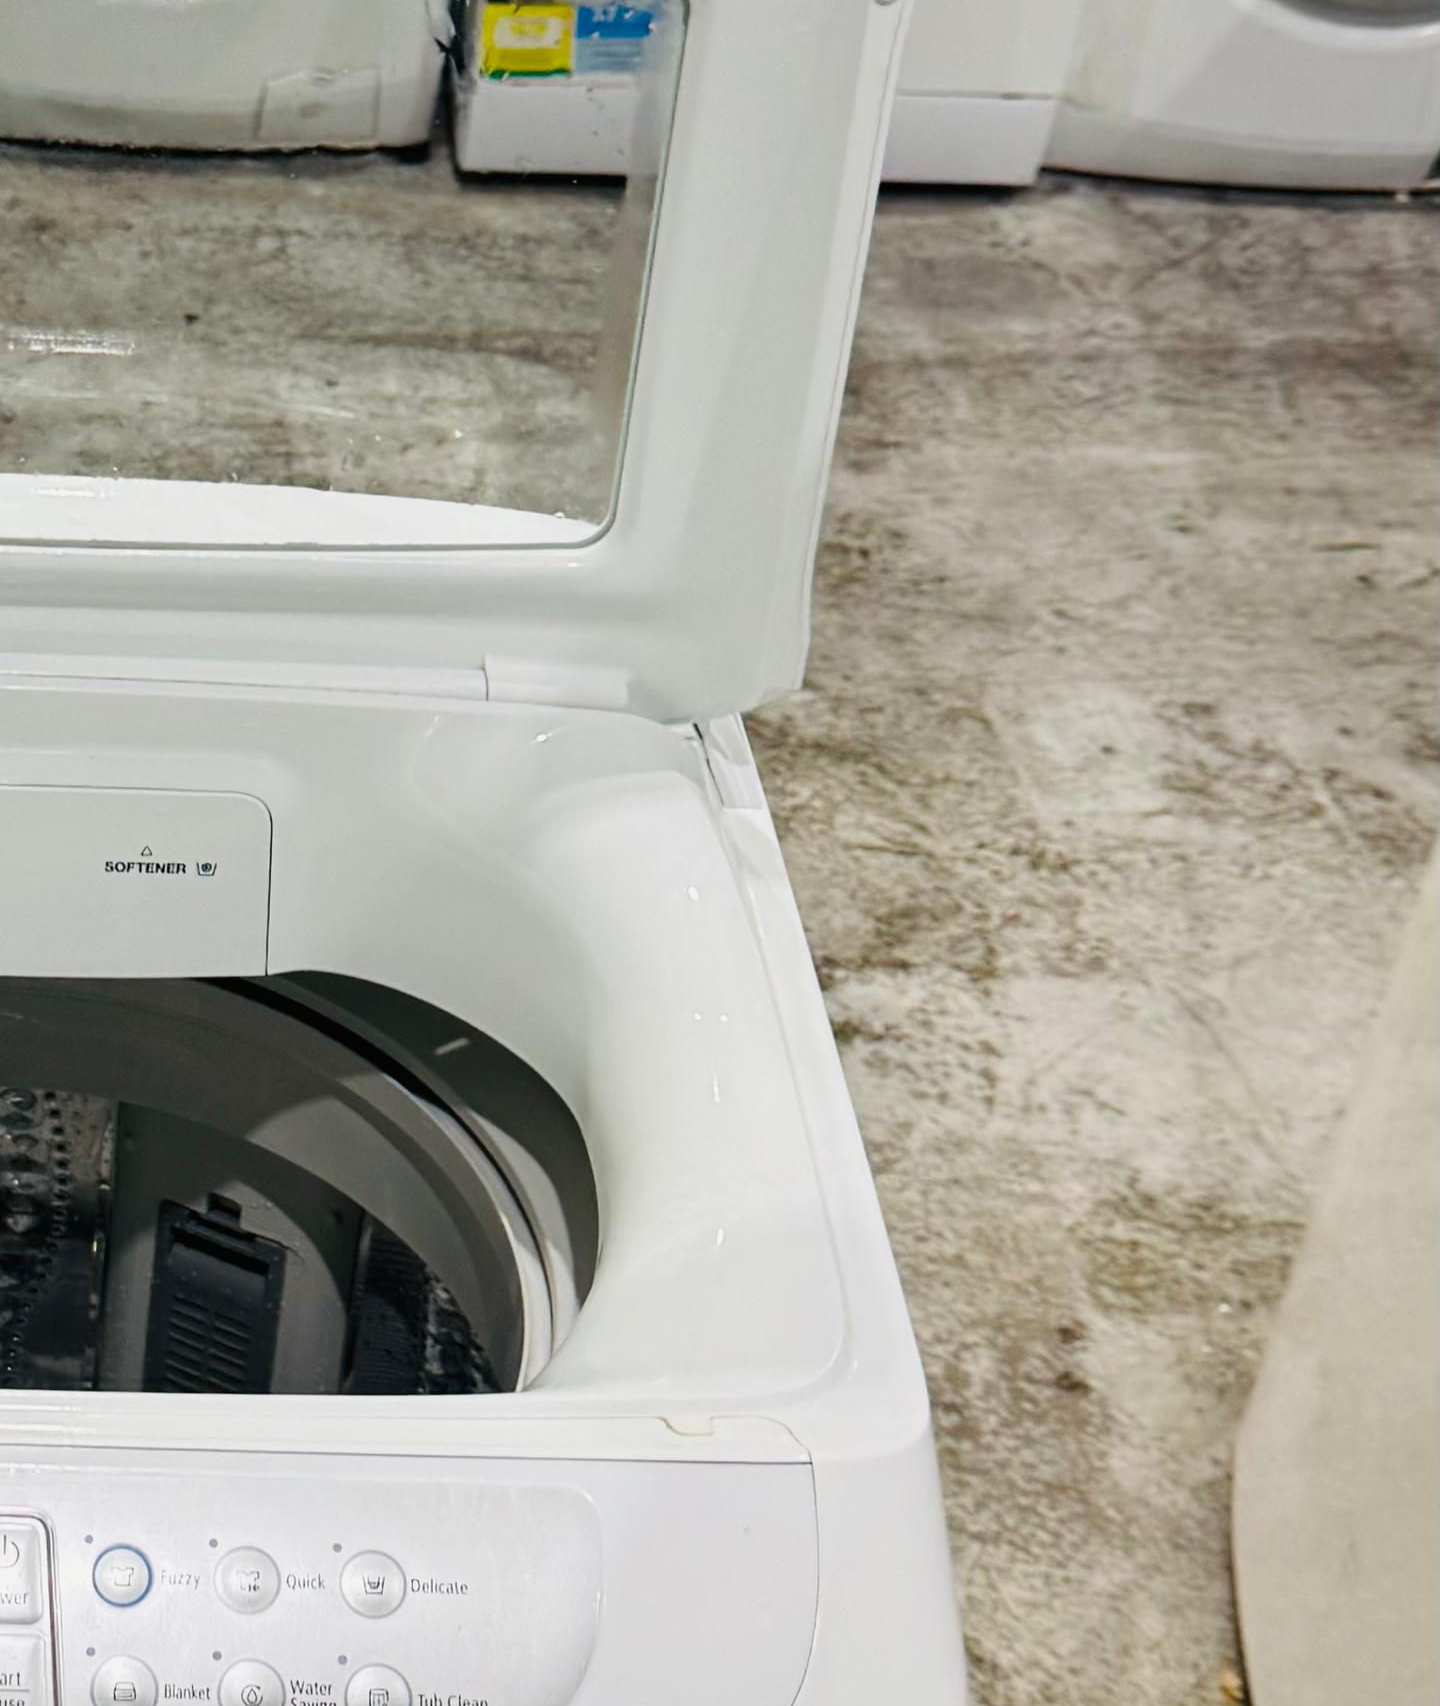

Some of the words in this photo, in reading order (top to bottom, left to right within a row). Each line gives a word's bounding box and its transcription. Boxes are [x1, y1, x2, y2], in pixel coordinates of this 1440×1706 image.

[104, 860, 187, 876] SOFTENER
[160, 1569, 201, 1590] Fuzzy
[286, 1573, 326, 1590] Quick
[410, 1578, 469, 1595] Delicate
[163, 1683, 211, 1701] Blanket
[289, 1679, 333, 1696] Water
